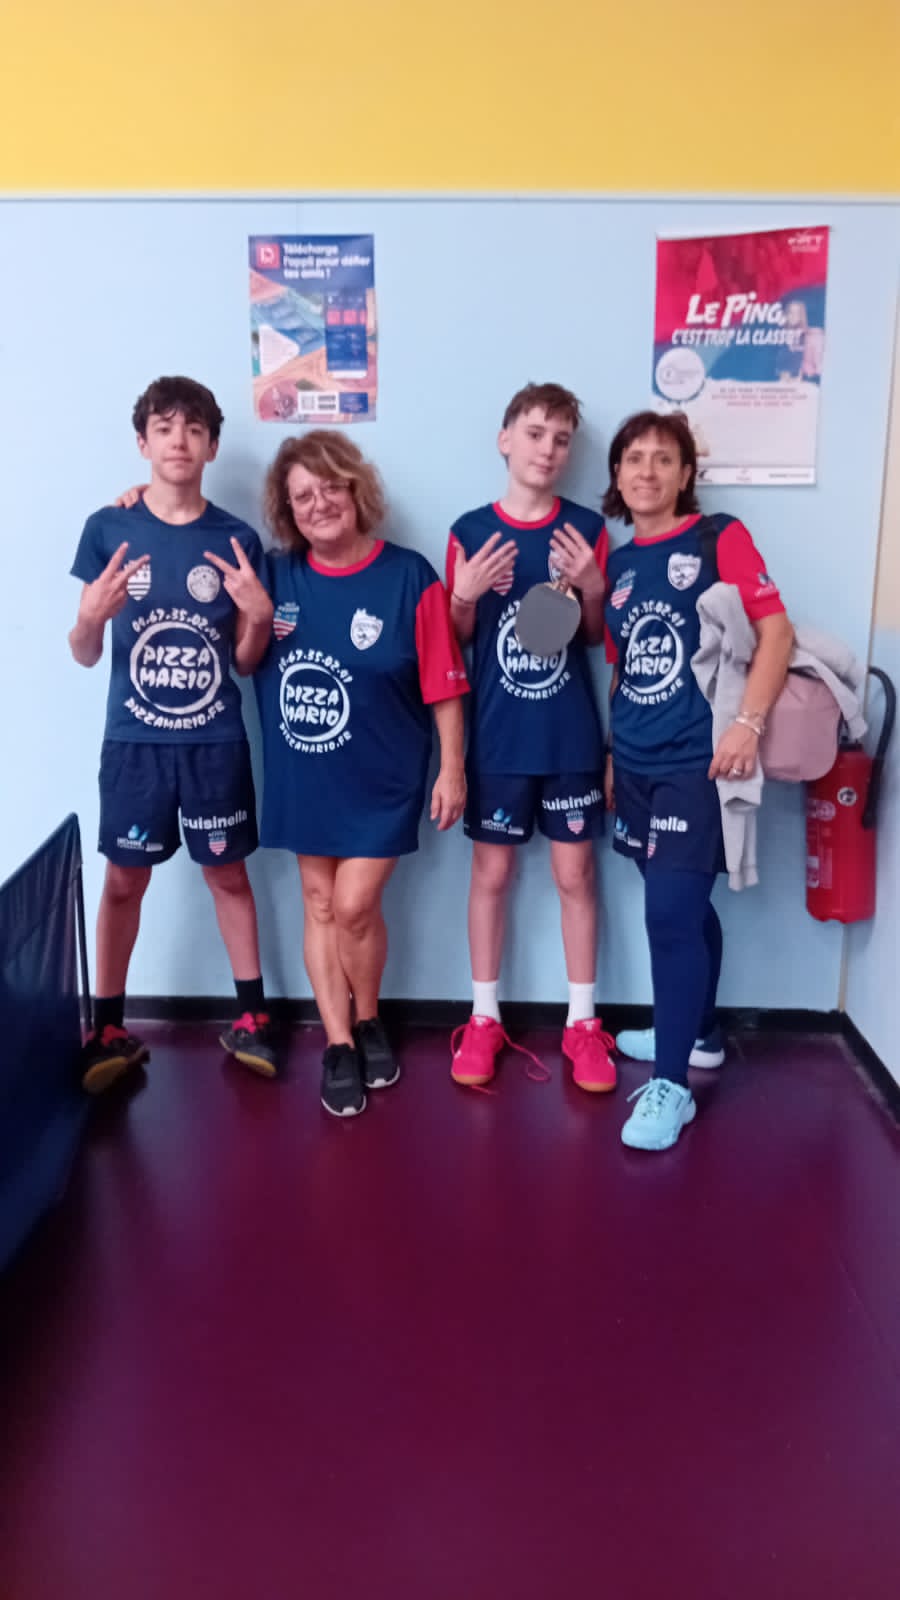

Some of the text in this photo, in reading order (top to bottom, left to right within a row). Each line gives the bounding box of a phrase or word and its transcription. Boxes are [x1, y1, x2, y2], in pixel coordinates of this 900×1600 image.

[283, 242, 339, 257] Télécharge
[316, 257, 339, 270] pour
[735, 329, 751, 346] LA
[143, 645, 211, 667] PIZZA
[506, 654, 559, 673] MARIO
[627, 656, 673, 676] ARIO
[139, 667, 212, 690] MARIO
[286, 684, 340, 706] PIZZA
[124, 697, 226, 730] PIZZAMARIO.FR
[182, 809, 248, 830] cuisinella
